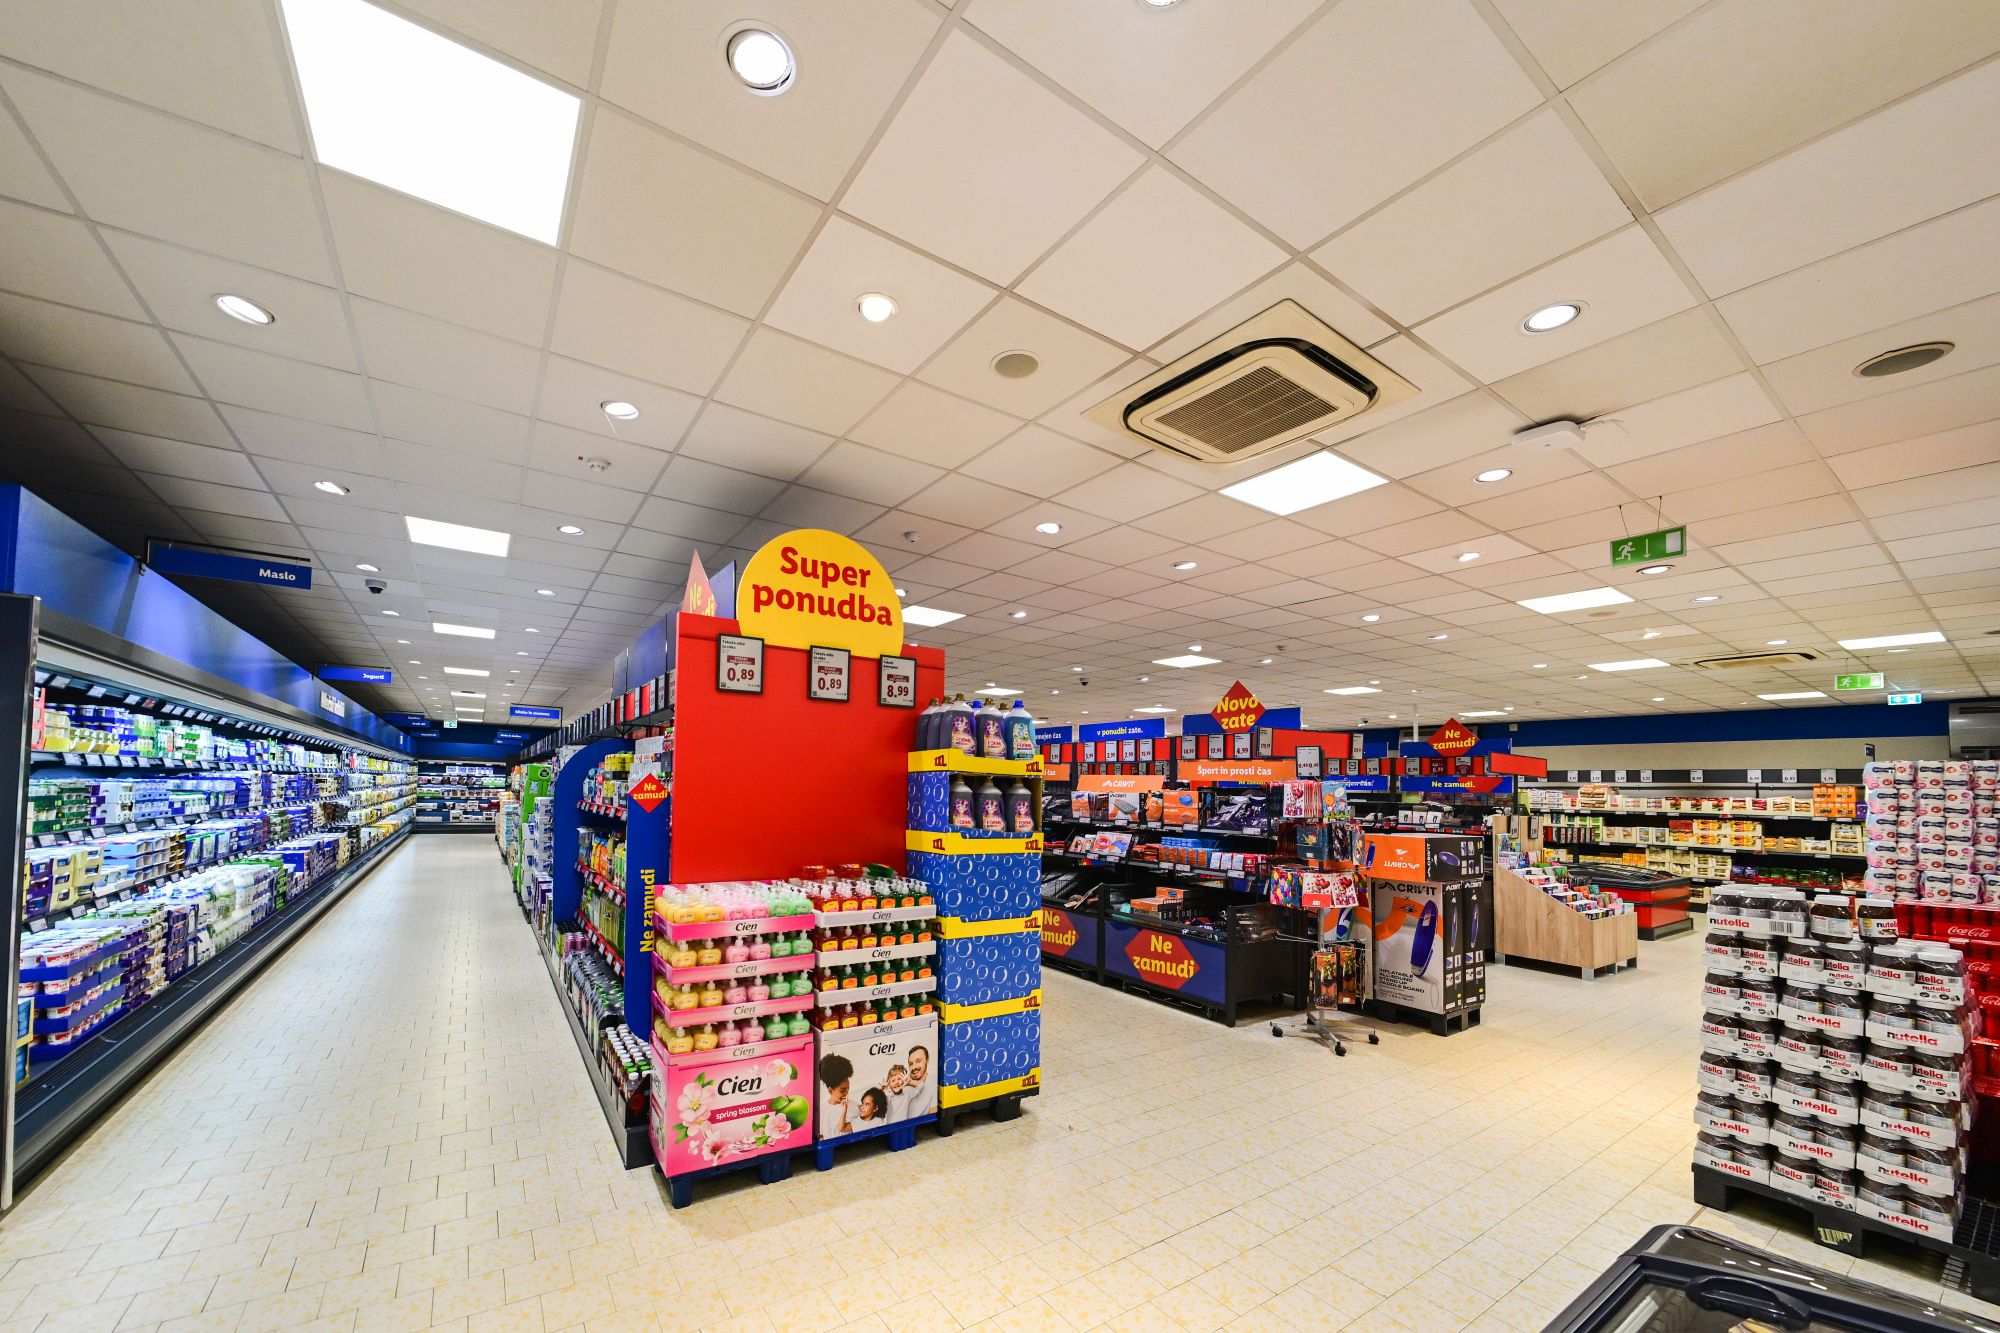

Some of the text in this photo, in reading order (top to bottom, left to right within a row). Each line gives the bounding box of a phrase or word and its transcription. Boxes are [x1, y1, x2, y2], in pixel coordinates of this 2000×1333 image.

[780, 546, 871, 589] Super
[259, 568, 296, 581] Maslo
[690, 583, 702, 613] Ne
[752, 583, 893, 627] ponudba
[727, 667, 755, 682] 0.89
[818, 677, 842, 691] 0.89
[886, 684, 909, 698] 8.99
[1216, 696, 1259, 714] Novo
[1221, 713, 1256, 730] zate
[1102, 727, 1127, 737] ponudbi
[1445, 729, 1460, 739] Ne
[1432, 737, 1476, 750] zamudi
[934, 755, 947, 767] XXL
[1025, 761, 1042, 772] XXL
[1197, 765, 1272, 776] Šport in prosti čas
[644, 782, 656, 791] Ne
[1444, 780, 1476, 788] zamudi.
[632, 788, 668, 800] zamudi
[932, 838, 945, 850] XXL
[1024, 839, 1042, 850] XXL
[1384, 860, 1408, 868] CRIVIT
[1396, 883, 1438, 896] CRIVIT
[640, 868, 656, 952] Ne zamudi
[872, 911, 892, 920] Cien
[1024, 917, 1040, 928] XXL
[1042, 909, 1060, 926] Ne
[1710, 918, 1750, 928] nutella
[736, 922, 758, 932] Cien
[1150, 934, 1172, 955] Ne
[872, 949, 891, 958] Cien
[735, 964, 758, 974] Cien
[1133, 956, 1195, 978] zamudi
[872, 987, 891, 996] Cien
[1024, 996, 1040, 1008] XXL
[733, 1005, 756, 1016] Cien
[1797, 1014, 1840, 1028] nutella
[874, 1024, 893, 1034] Cien
[1887, 1031, 1938, 1046] nutella
[732, 1046, 754, 1057] Cien
[869, 1042, 896, 1056] Cien
[1826, 1059, 1852, 1068] nutella
[717, 1075, 762, 1096] Cien
[1022, 1075, 1038, 1088] XXL
[1919, 1078, 1948, 1088] nutella
[716, 1104, 766, 1121] spring blossom
[1792, 1098, 1838, 1116] nutella
[1710, 1119, 1750, 1134] nutella
[1880, 1120, 1931, 1139] nutella
[1788, 1140, 1833, 1159] nutella
[1710, 1159, 1750, 1177] nutella
[1878, 1166, 1928, 1185] nutella
[1820, 1190, 1846, 1200] nutella
[1878, 1211, 1929, 1232] nutella
